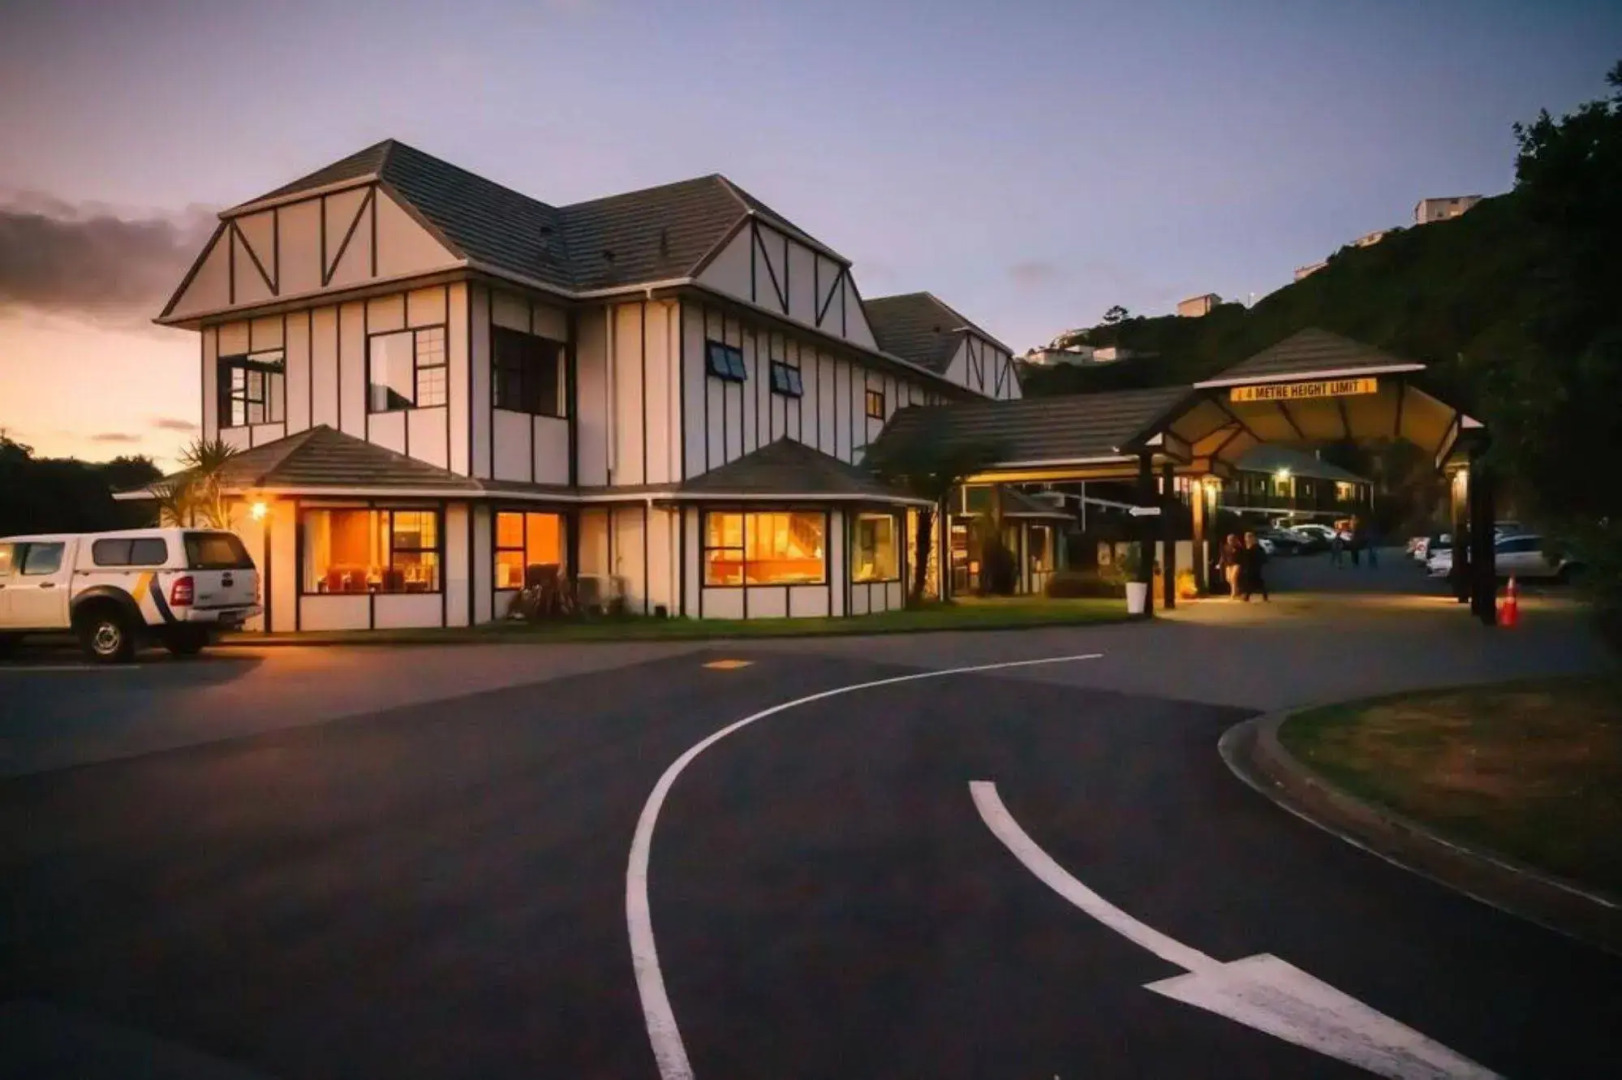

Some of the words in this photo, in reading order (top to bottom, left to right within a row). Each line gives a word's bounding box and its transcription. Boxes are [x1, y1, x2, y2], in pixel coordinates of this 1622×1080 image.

[1256, 385, 1288, 398] METRE
[1291, 383, 1327, 396] HEIGHT
[1330, 380, 1359, 394] LIMIT
